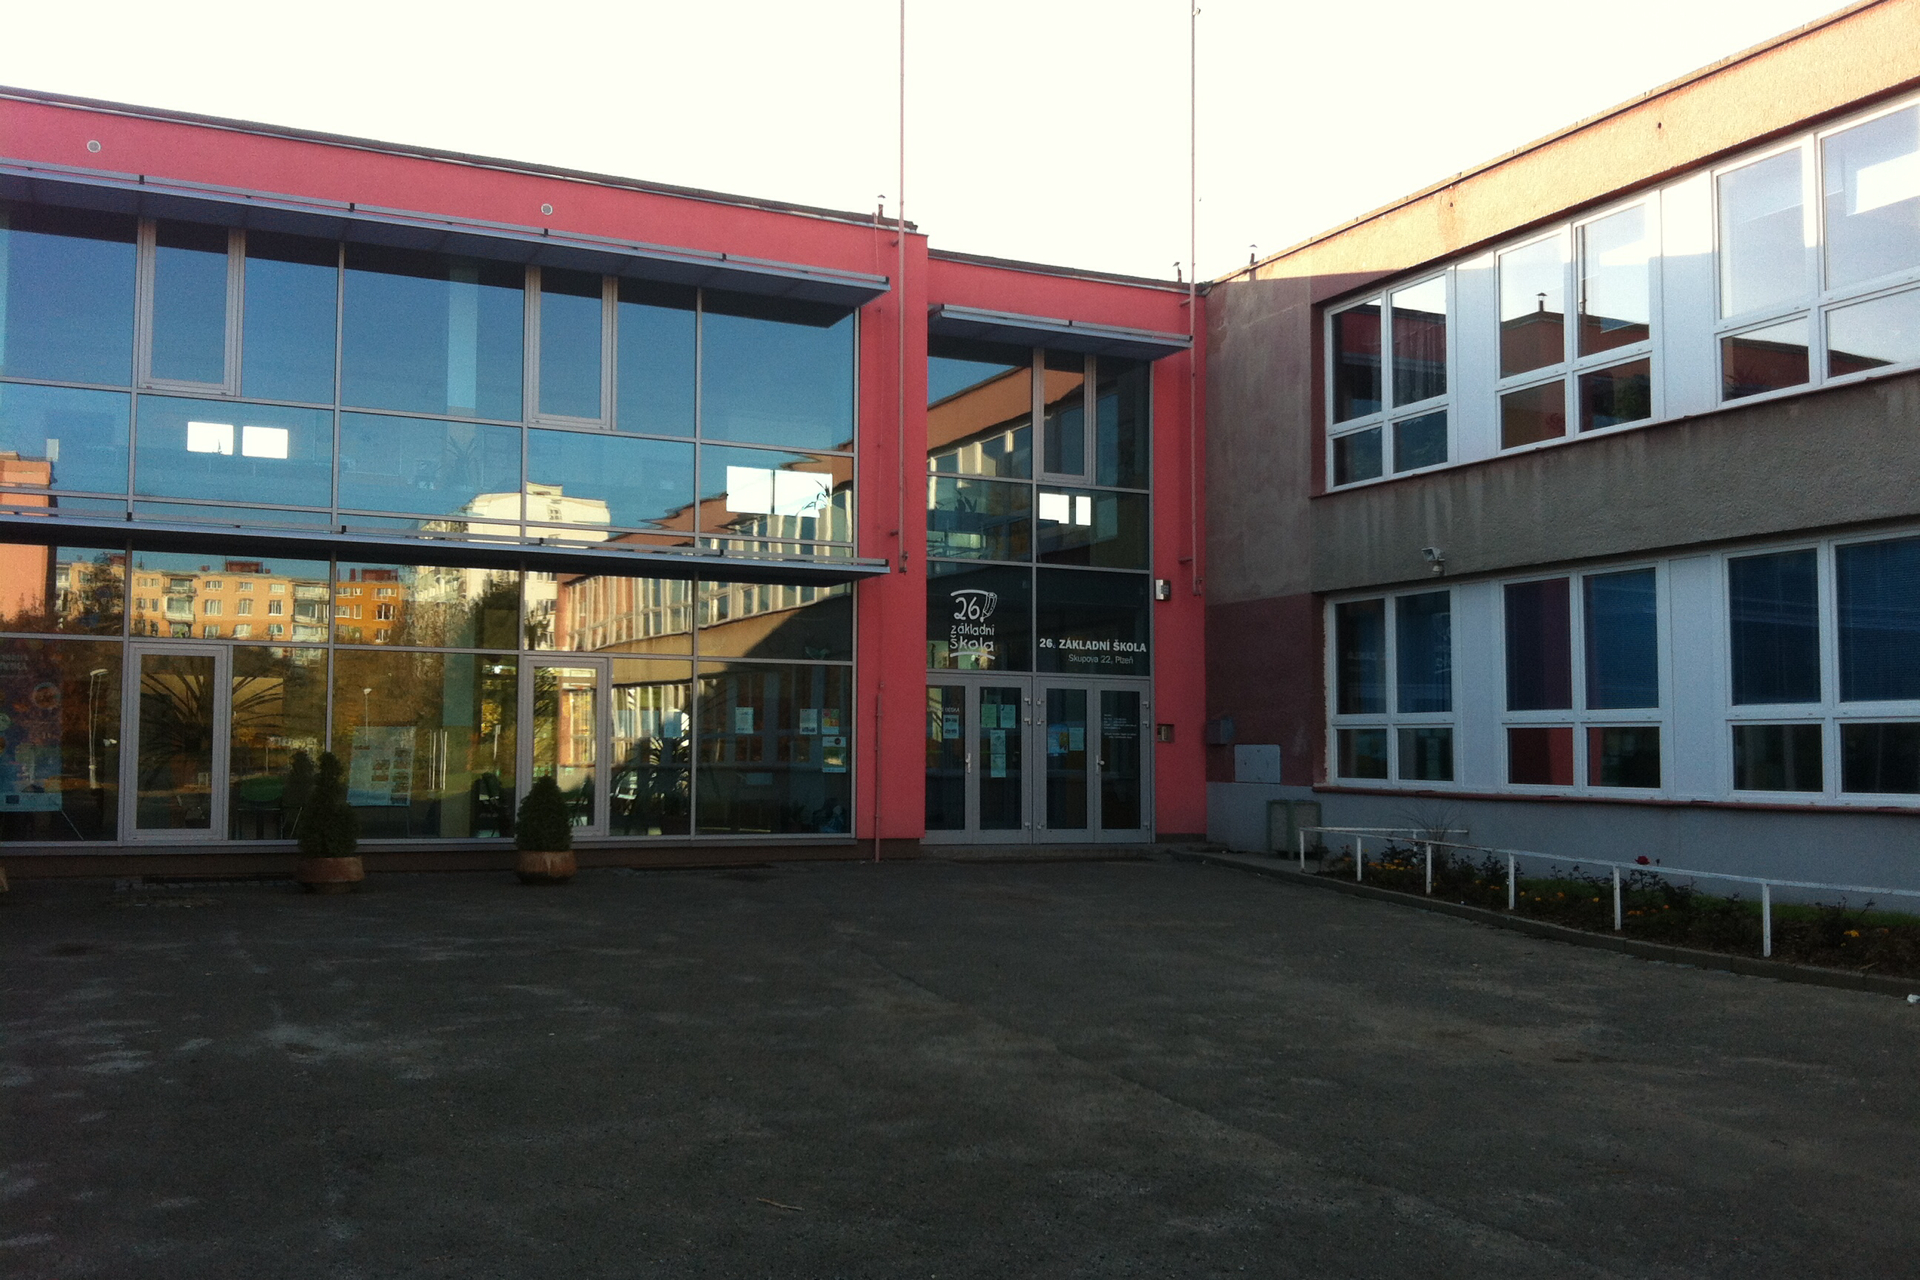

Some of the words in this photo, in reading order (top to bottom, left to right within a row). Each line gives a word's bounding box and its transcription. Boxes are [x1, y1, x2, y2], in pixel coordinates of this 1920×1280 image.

[953, 596, 981, 620] 26
[950, 622, 995, 636] základní
[1039, 638, 1056, 649] 26.
[1058, 637, 1110, 651] ZÁKLADNÍ
[1113, 639, 1147, 652] ŠKOLA
[1068, 653, 1099, 664] Skupova
[1115, 655, 1134, 664] Plzeň
